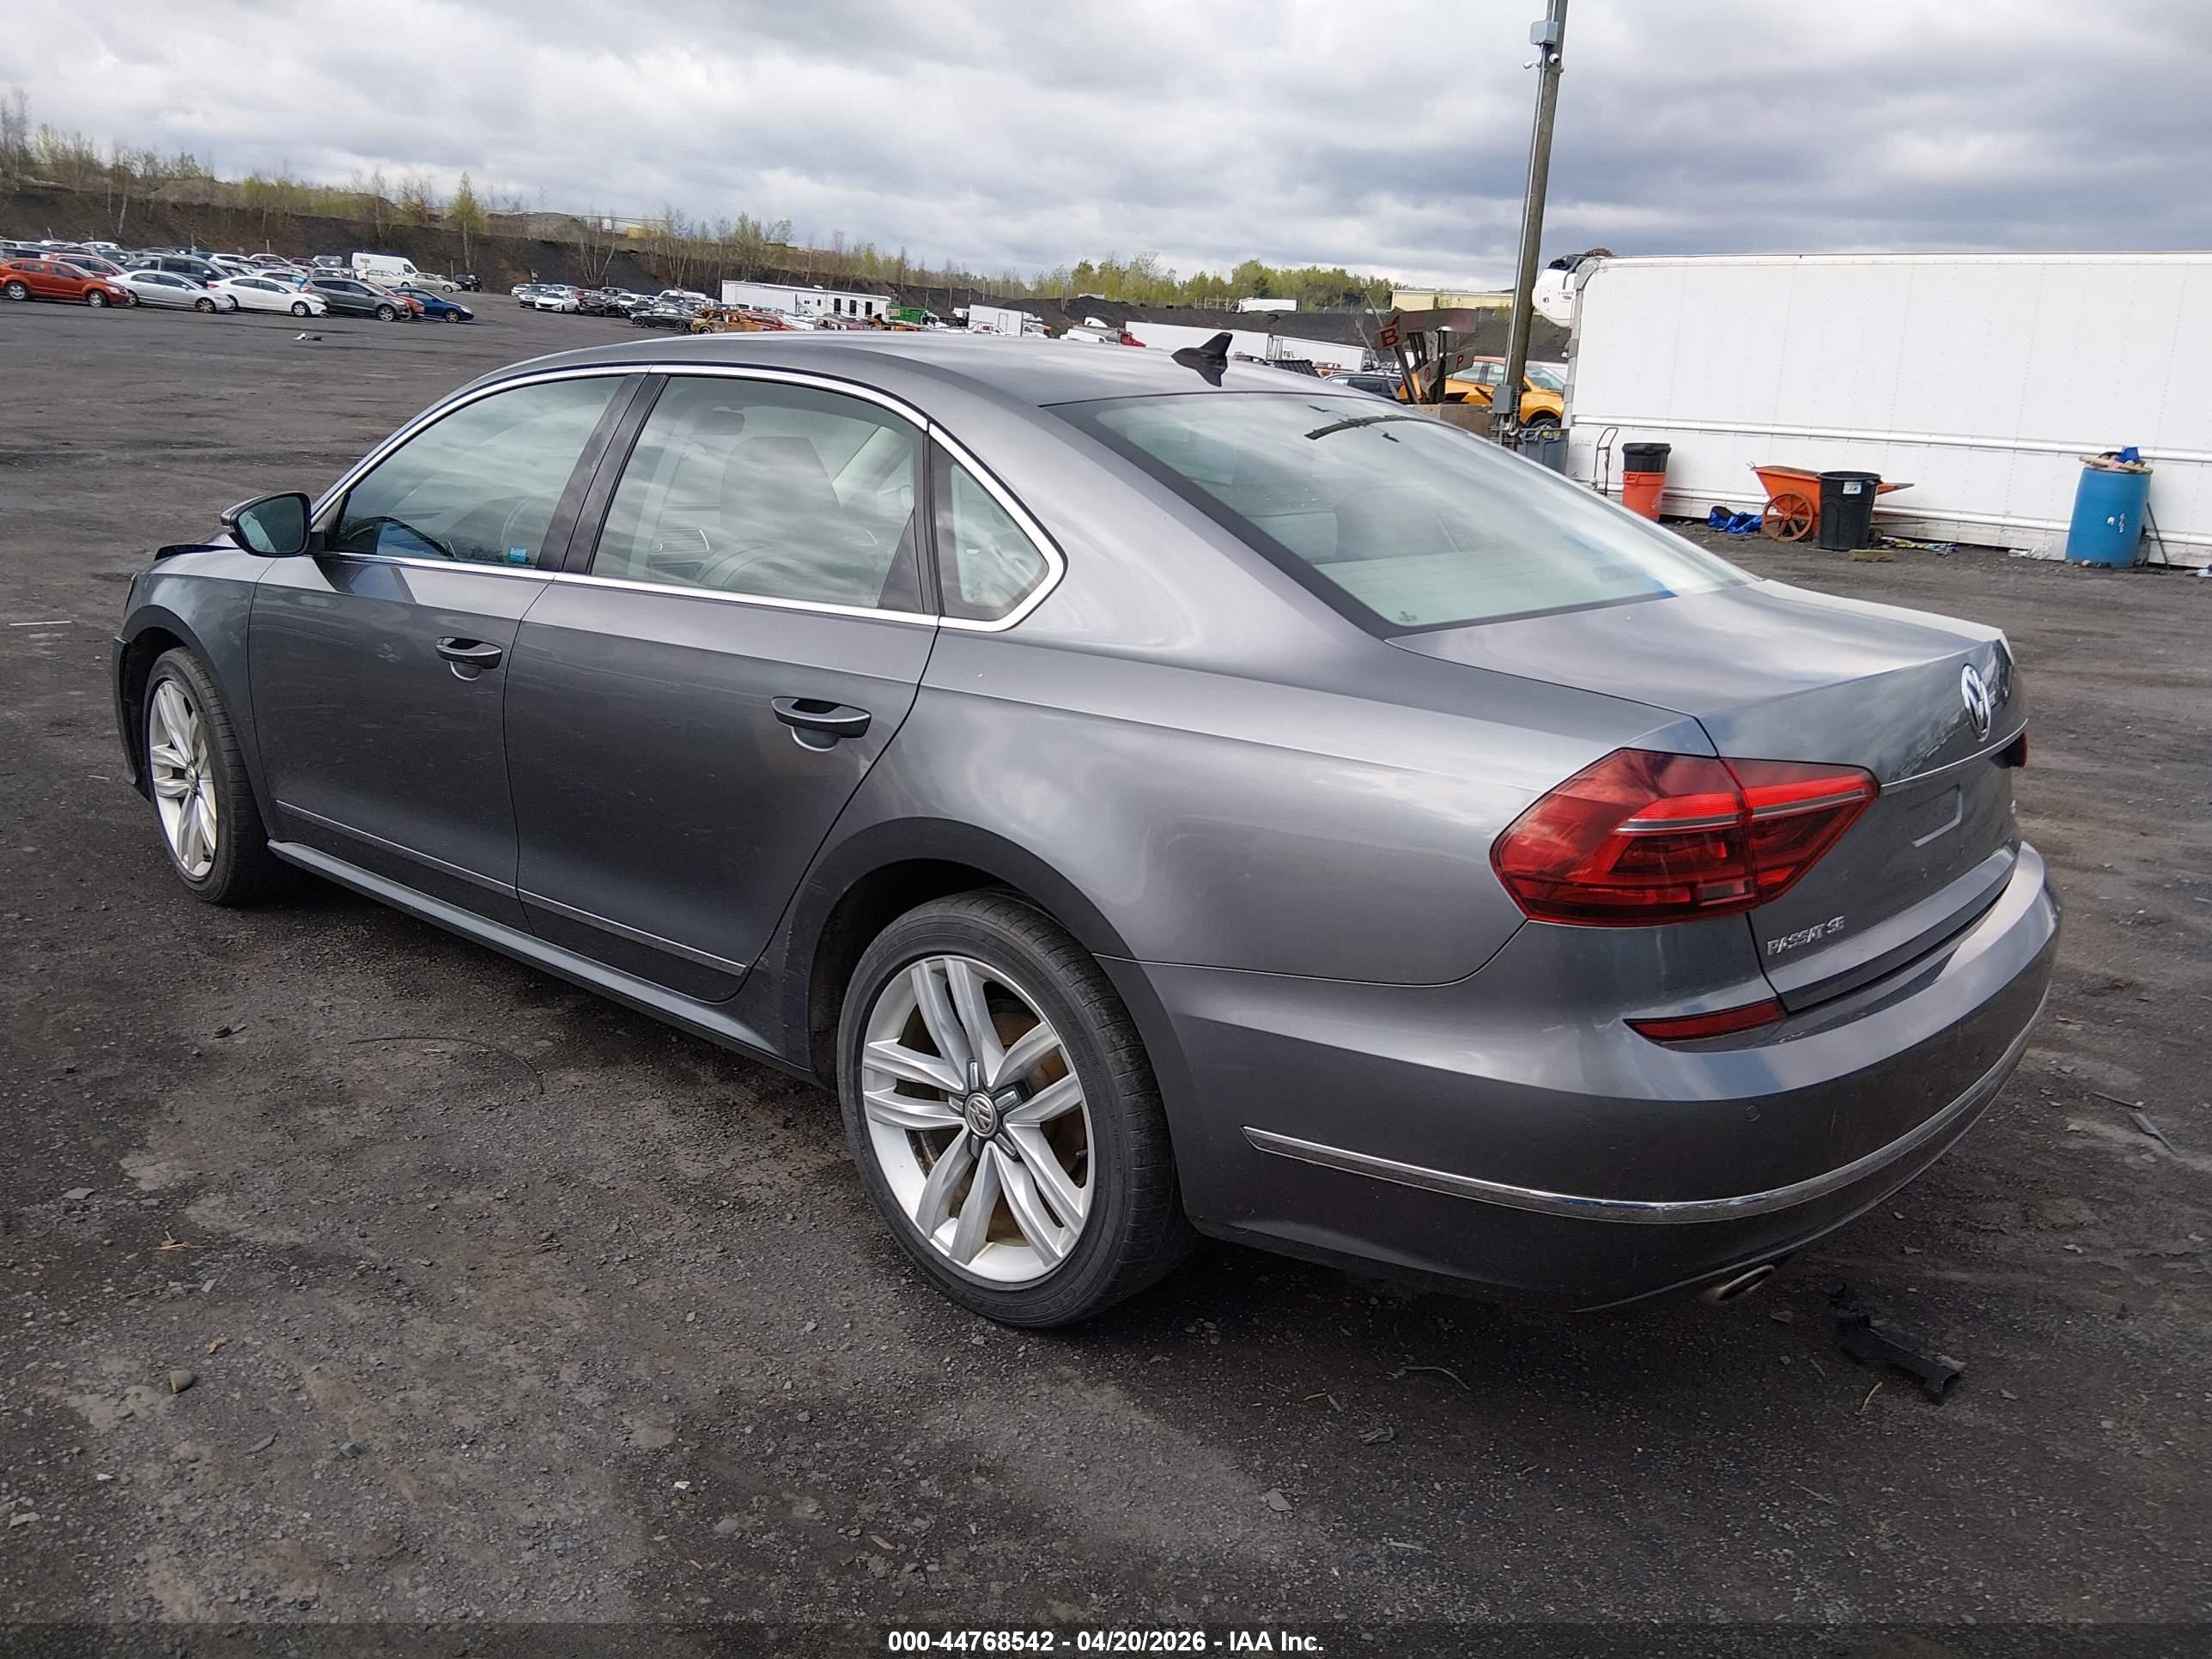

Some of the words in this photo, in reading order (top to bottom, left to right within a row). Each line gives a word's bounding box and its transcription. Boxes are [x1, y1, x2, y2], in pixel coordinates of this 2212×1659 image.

[1381, 328, 1400, 348] B
[1456, 354, 1464, 370] P
[1766, 922, 1826, 956] PASSAT
[1826, 915, 1844, 934] SE
